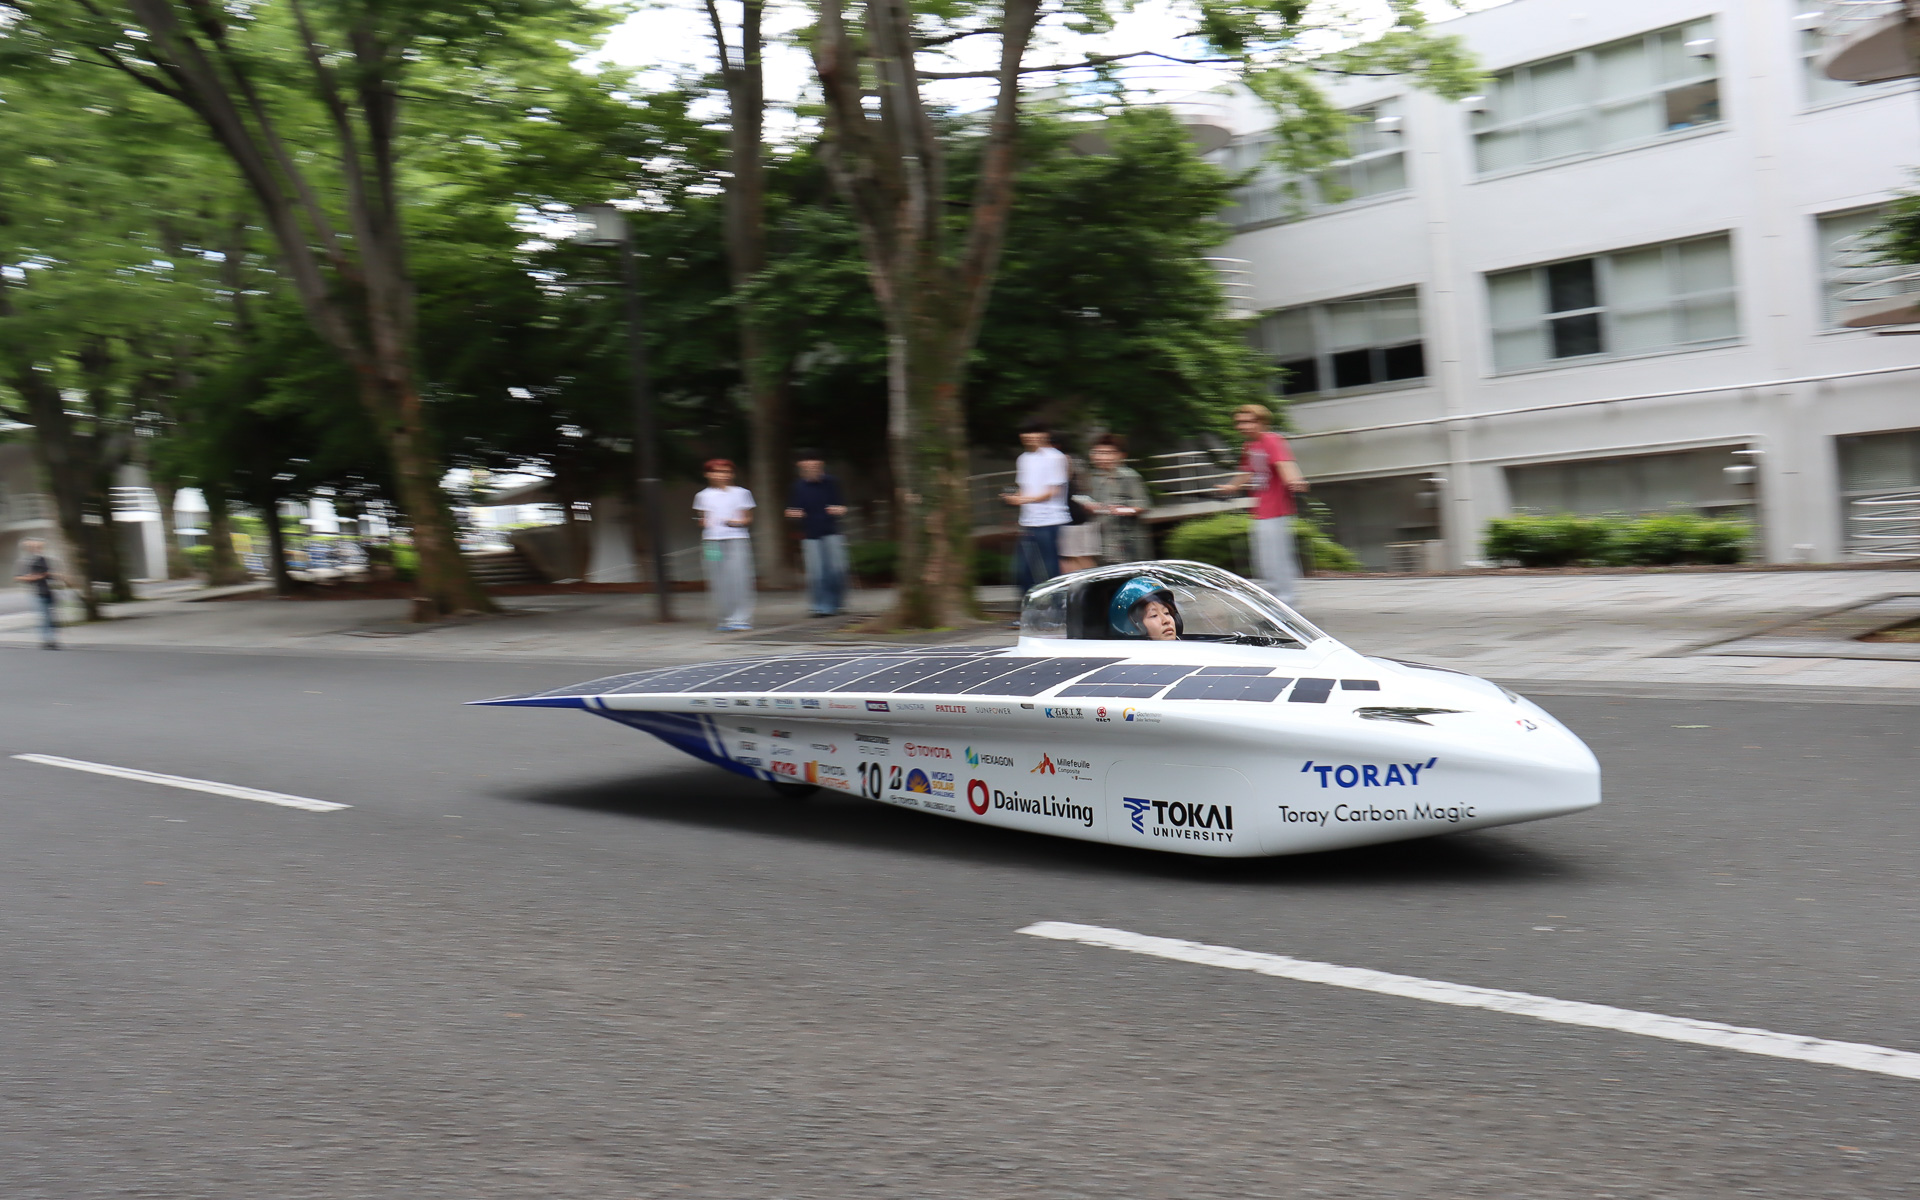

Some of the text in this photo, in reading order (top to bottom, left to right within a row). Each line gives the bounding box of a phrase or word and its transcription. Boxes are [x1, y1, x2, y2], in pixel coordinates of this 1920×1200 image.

[935, 704, 967, 713] PATLITE
[976, 706, 1012, 715] SUNPOWER
[917, 745, 952, 759] TOYOTA
[980, 754, 1014, 767] HEXAGON
[1056, 757, 1091, 769] Millefeuille
[931, 771, 954, 782] WORLD
[1057, 767, 1081, 775] Composite
[857, 761, 882, 800] 10
[931, 780, 955, 792] SOLAR
[931, 790, 955, 799] CHALLENGE
[994, 789, 1094, 827] Daiwa Living
[1152, 800, 1233, 830] TOKAI
[1278, 802, 1476, 827] Toray Carbon Magic
[1153, 827, 1233, 842] UNIVERSITY
